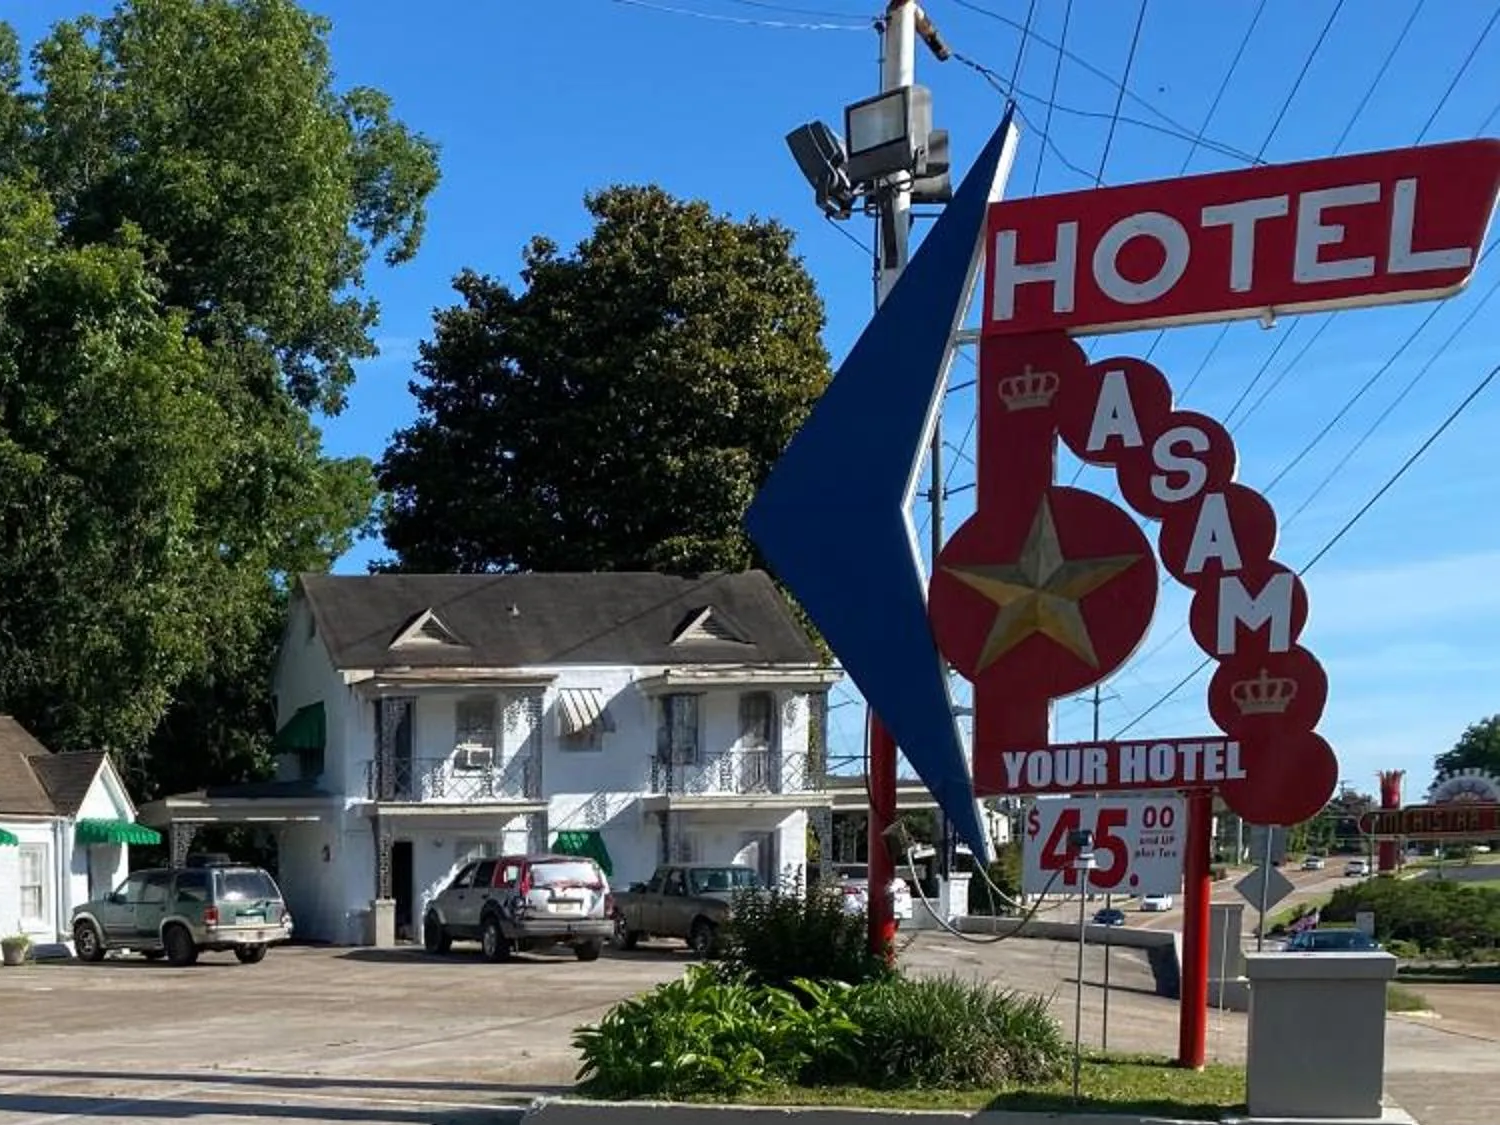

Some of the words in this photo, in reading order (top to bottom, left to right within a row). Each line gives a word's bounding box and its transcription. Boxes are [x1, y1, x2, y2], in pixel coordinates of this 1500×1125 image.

[992, 177, 1472, 322] HOTEL
[1002, 747, 1109, 789] YOUR
[1119, 741, 1247, 783] HOTEL
